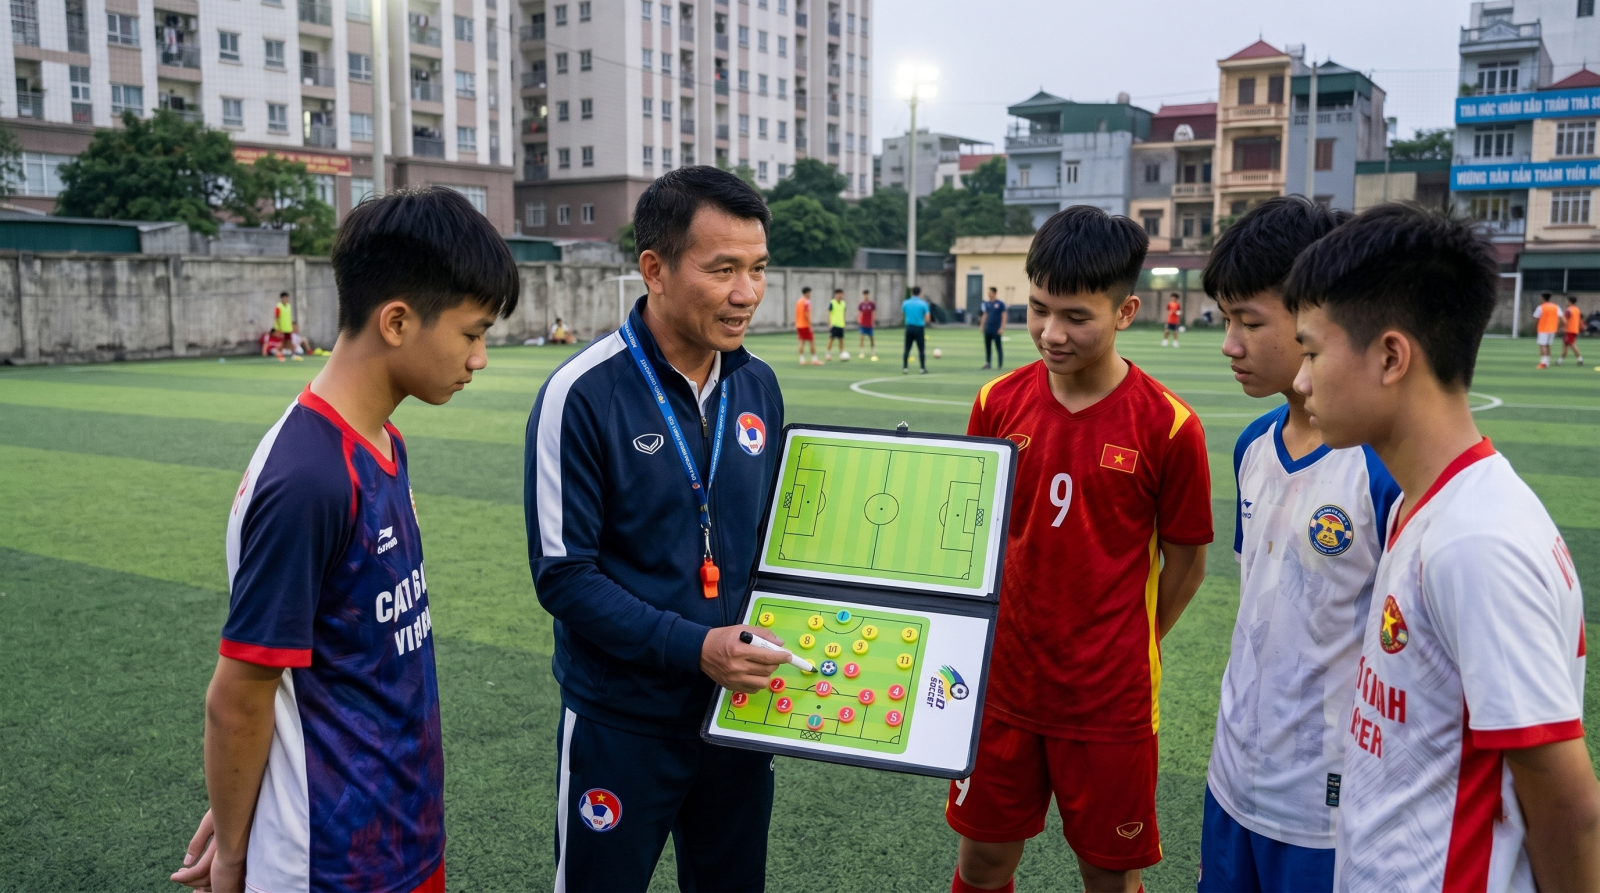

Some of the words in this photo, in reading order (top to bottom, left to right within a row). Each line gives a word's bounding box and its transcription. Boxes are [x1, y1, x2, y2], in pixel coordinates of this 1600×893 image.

[1049, 472, 1073, 528] 9
[804, 635, 811, 645] 8
[900, 656, 910, 665] 11
[848, 664, 855, 674] 9
[817, 682, 829, 692] 10
[892, 687, 900, 696] 4
[863, 691, 870, 701] 5
[955, 776, 971, 807] 9
